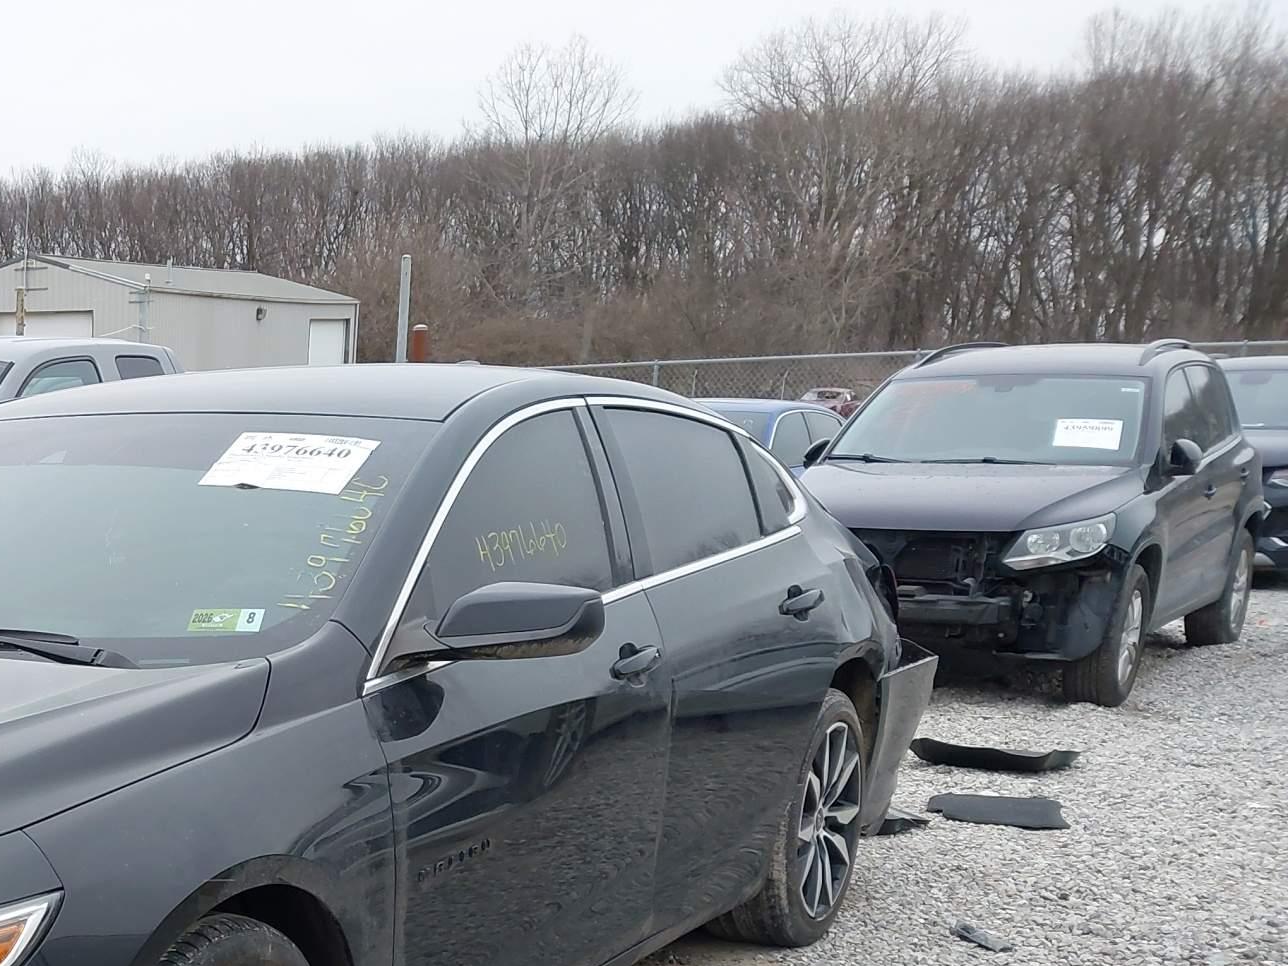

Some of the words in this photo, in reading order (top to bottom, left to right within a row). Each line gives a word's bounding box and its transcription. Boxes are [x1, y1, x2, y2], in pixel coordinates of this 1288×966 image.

[242, 442, 352, 459] 43976640
[475, 519, 567, 572] 43976640
[191, 612, 214, 624] 2026
[246, 611, 257, 624] 8
